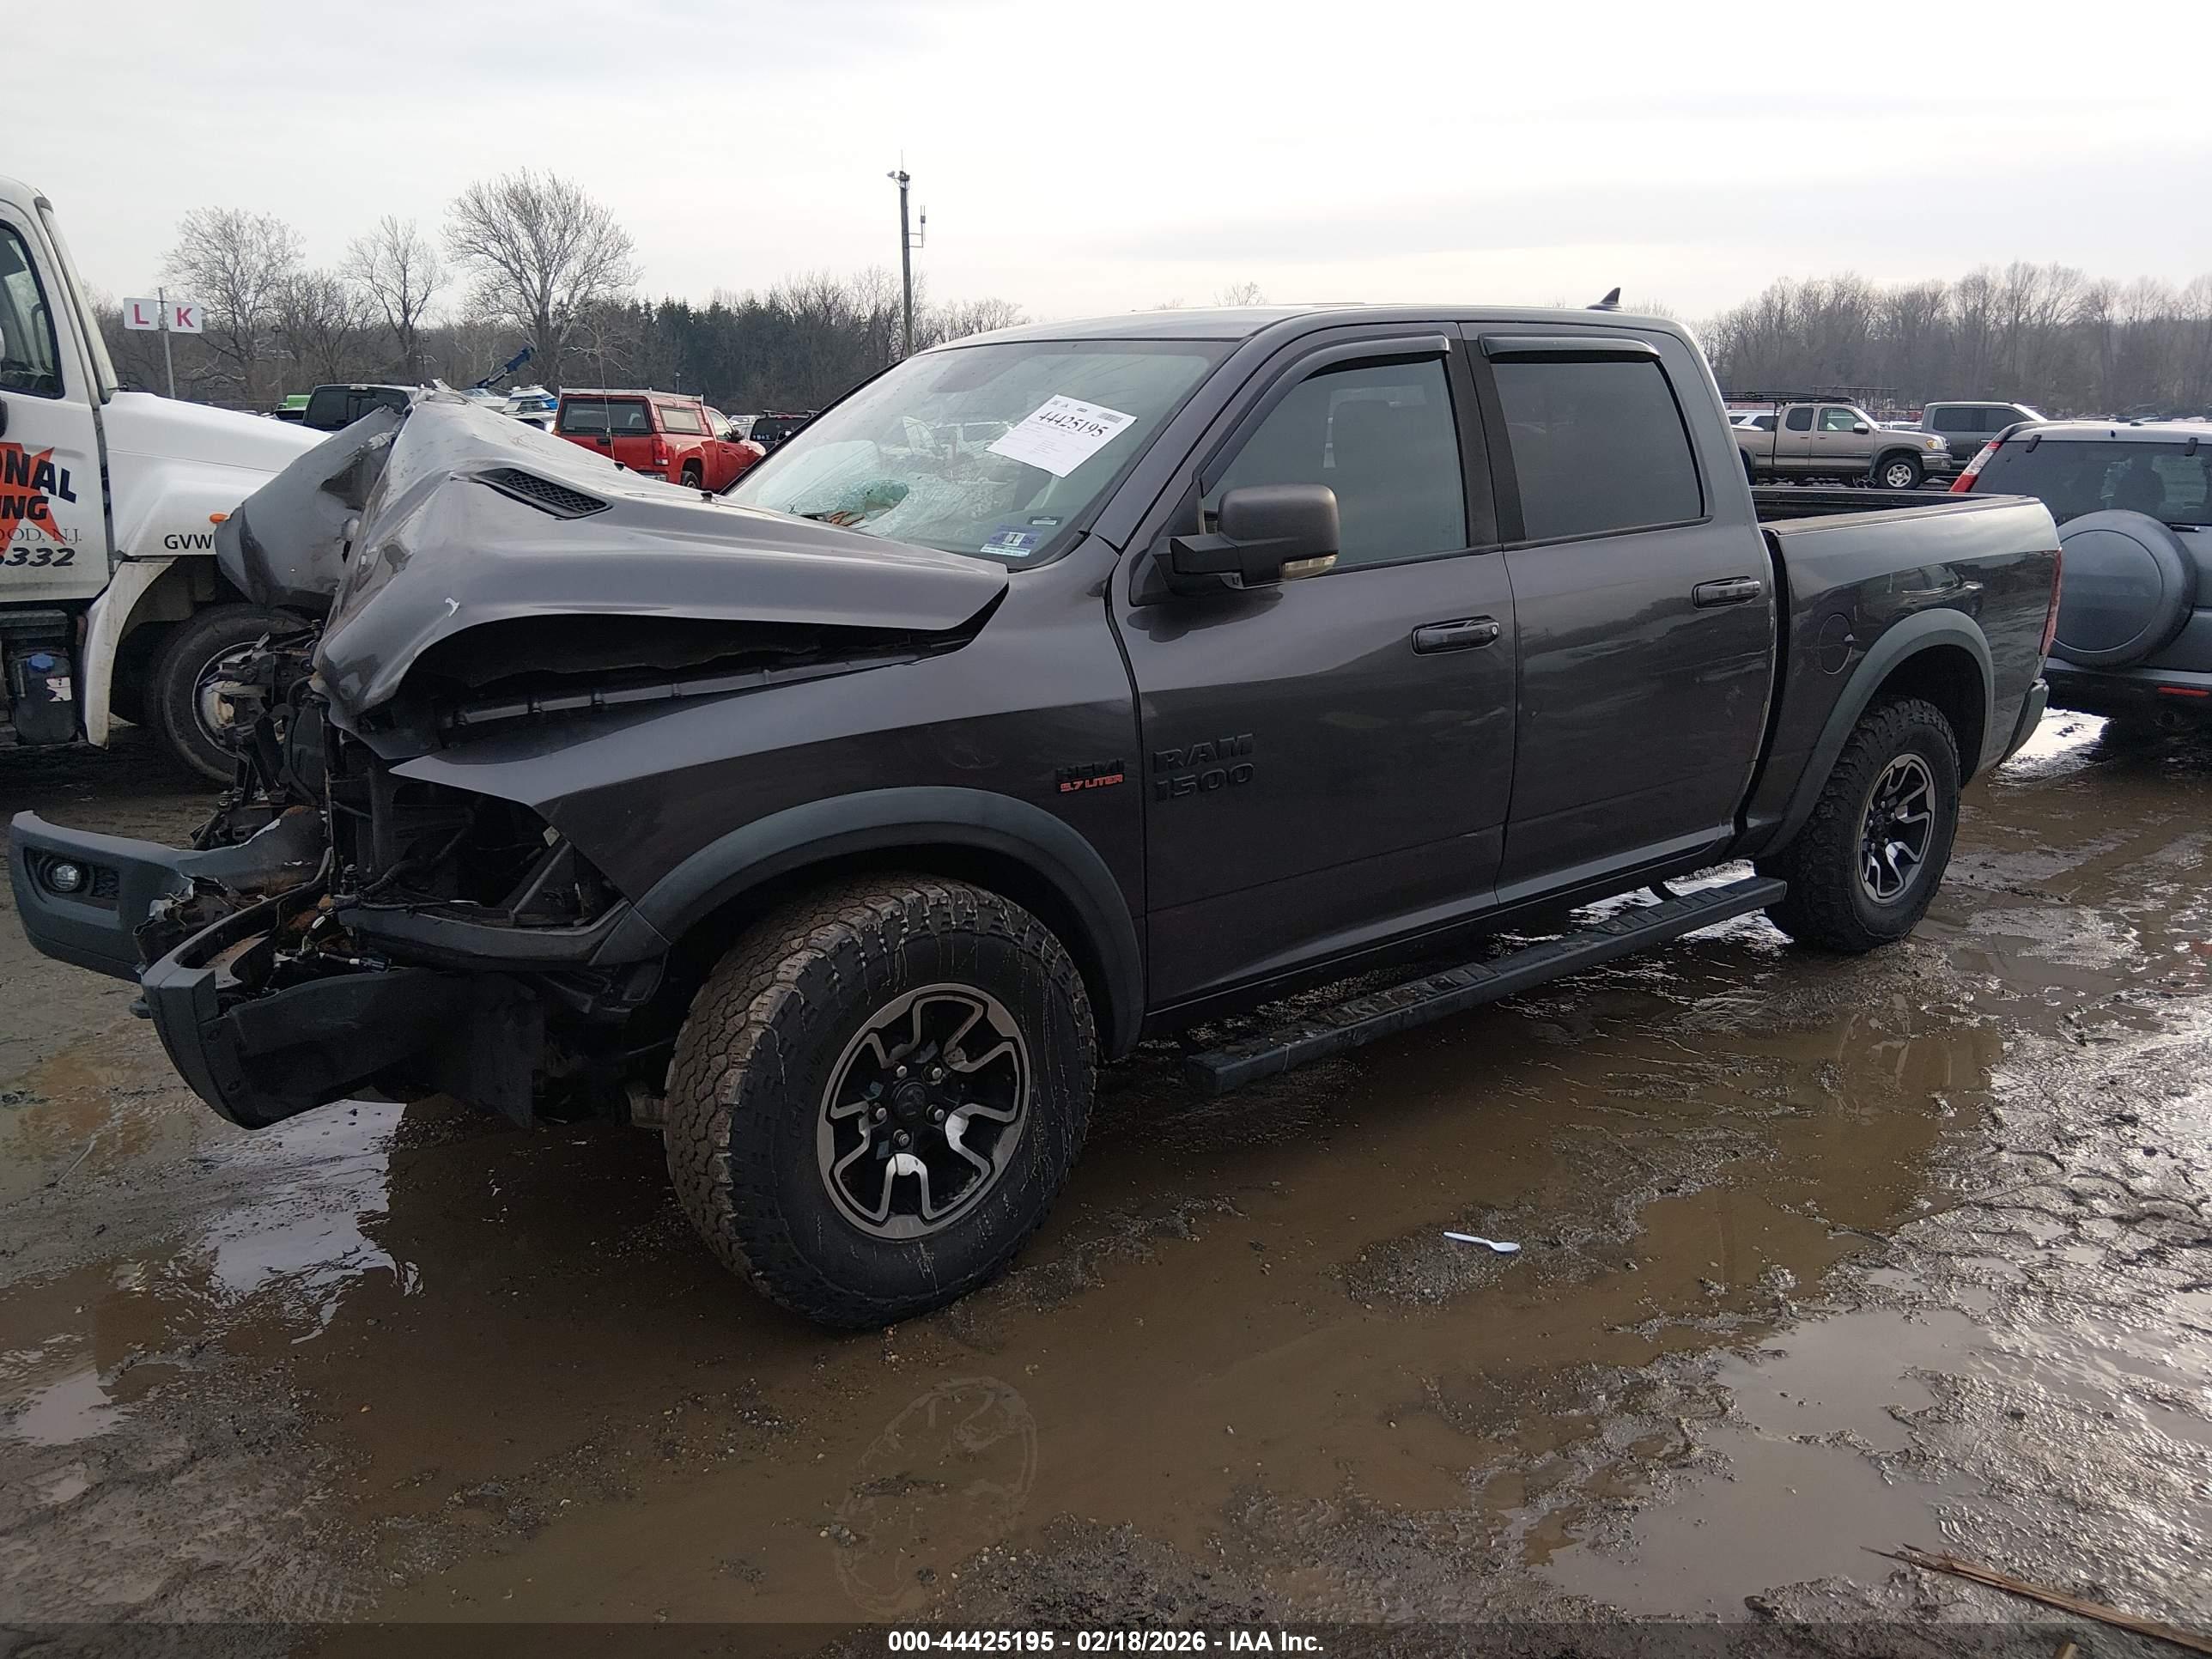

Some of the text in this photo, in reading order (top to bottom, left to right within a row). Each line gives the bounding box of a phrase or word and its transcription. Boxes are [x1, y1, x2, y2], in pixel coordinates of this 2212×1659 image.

[134, 303, 150, 325] L
[176, 307, 195, 328] K
[1038, 410, 1109, 437] 44425195
[0, 448, 77, 504] NAL
[0, 495, 50, 520] NG
[164, 534, 213, 550] GVW
[0, 546, 76, 567] 332
[1153, 732, 1254, 774] RAM
[1060, 774, 1124, 793] 5.7 LITER
[1156, 763, 1255, 802] 1500
